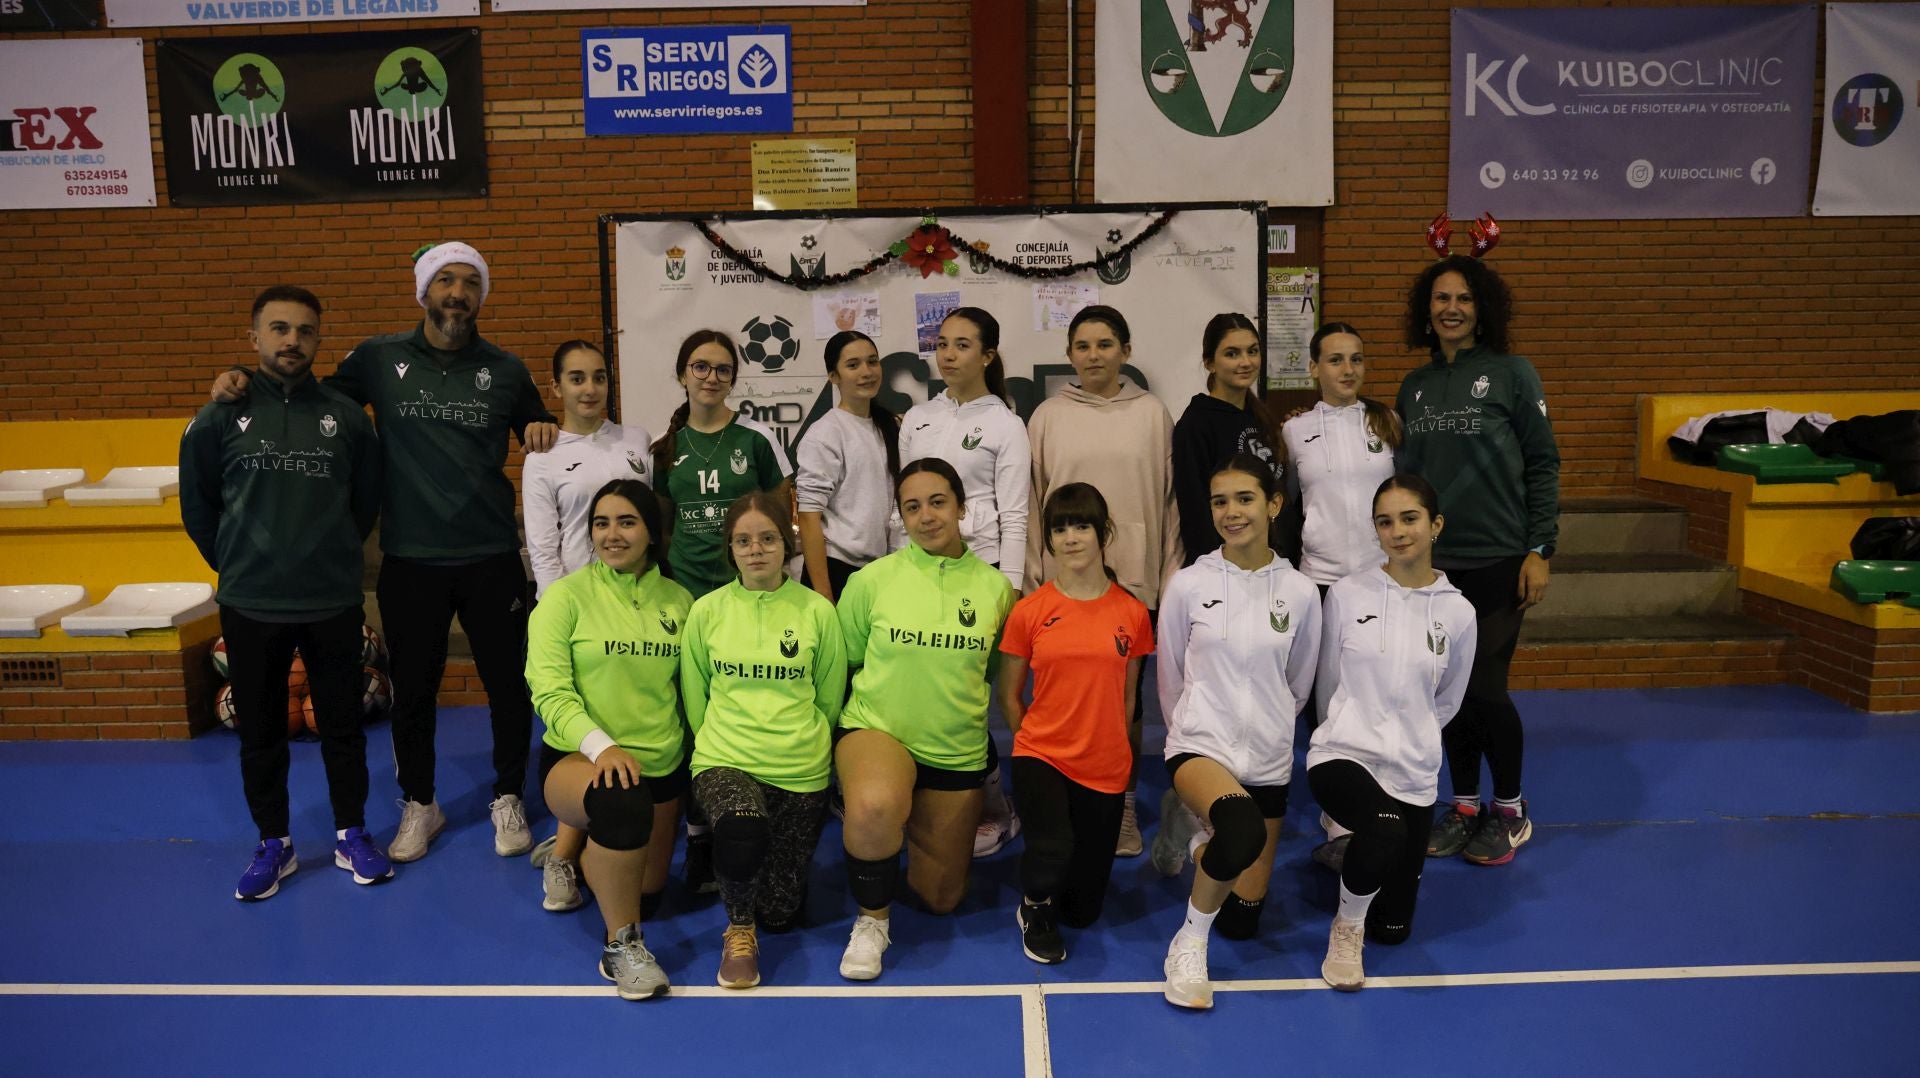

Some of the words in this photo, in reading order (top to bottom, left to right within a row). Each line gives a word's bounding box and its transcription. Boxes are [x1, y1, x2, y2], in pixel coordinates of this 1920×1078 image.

[187, 1, 300, 20] VALVERDE
[307, 0, 334, 16] DE
[646, 41, 725, 63] SERVI
[649, 69, 727, 91] RIEGOS
[1558, 56, 1784, 88] KUIBOCLINIC
[1465, 53, 1557, 117] KC
[614, 104, 763, 119] www.servirriegos.es
[1563, 102, 1609, 114] CLÍNICA
[1613, 103, 1628, 114] DE
[1631, 102, 1707, 114] FISIOTERAPIA
[1711, 103, 1719, 113] Y
[1721, 100, 1792, 113] OSTEOPATÍA
[190, 100, 296, 171] MONKI
[350, 94, 456, 165] MONKI
[54, 155, 69, 165] DE
[73, 154, 105, 165] HIELO
[64, 169, 128, 181] 635249154
[217, 175, 255, 187] LOUNGE
[261, 174, 279, 185] BAR
[377, 170, 415, 182] LOUNGE
[422, 169, 440, 179] BAR
[1512, 169, 1538, 181] 640
[1542, 169, 1558, 180] 33
[1562, 168, 1579, 180] 92
[1583, 168, 1600, 180] 96
[1659, 167, 1744, 180] KUIBOCLINIC
[67, 184, 129, 196] 670331889
[1016, 240, 1069, 253] CONCEJALÍA
[707, 262, 720, 272] DE
[1012, 255, 1024, 266] DE
[1027, 254, 1073, 266] DEPORTES
[712, 274, 719, 283] Y
[720, 273, 765, 286] JUVENTUD
[399, 406, 489, 425] VALVERDE
[1408, 419, 1481, 436] VALVERDE
[240, 458, 332, 475] VALVERDE
[698, 469, 720, 495] 14
[890, 627, 988, 652] VOLEIBOL
[713, 659, 806, 680] VOLEIBOL
